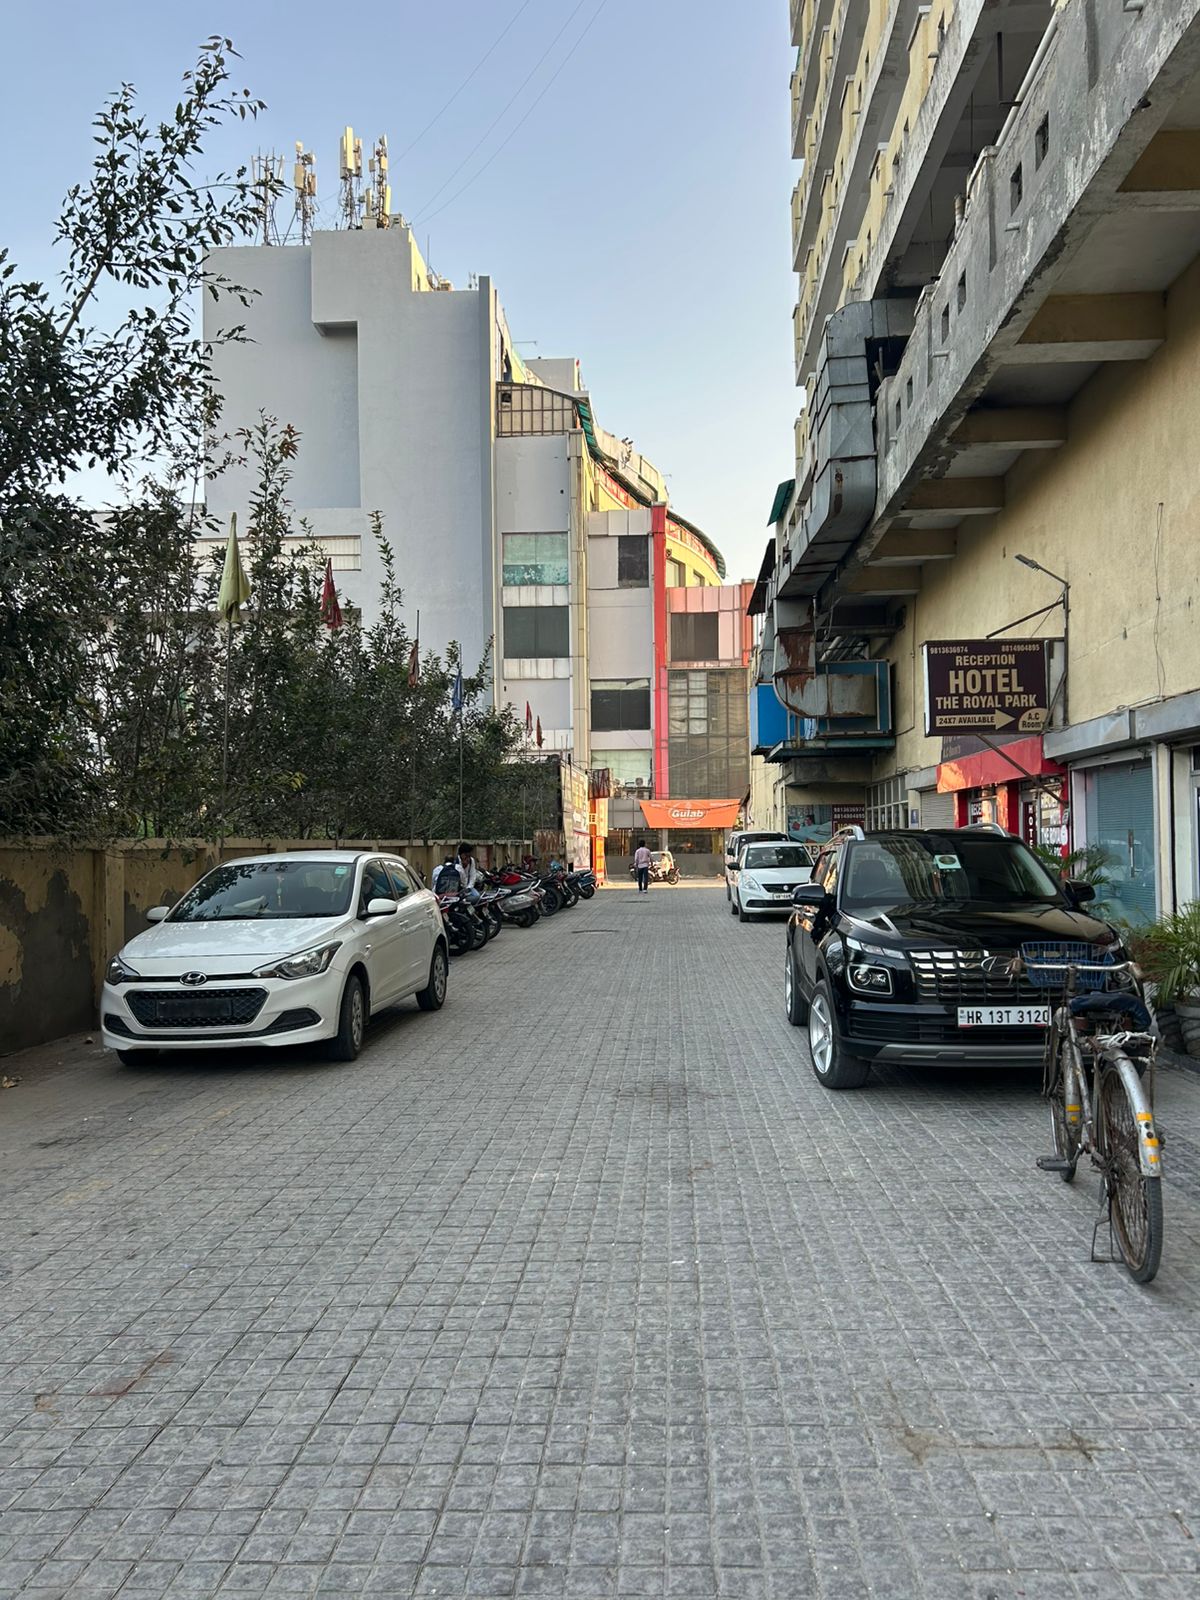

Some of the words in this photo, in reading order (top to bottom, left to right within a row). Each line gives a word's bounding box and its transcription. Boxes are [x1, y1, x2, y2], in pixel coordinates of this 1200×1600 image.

[955, 654, 1016, 666] RECEPTION
[949, 668, 1024, 694] HOTEL
[936, 696, 959, 709] THE
[963, 695, 1001, 709] ROYAL
[1005, 694, 1037, 707] PARK
[939, 717, 956, 725] 24X7
[958, 716, 995, 724] AVAILABLE
[1028, 712, 1040, 721] A.C
[671, 809, 704, 818] Gulab
[967, 1010, 983, 1024] HR
[989, 1010, 1011, 1023] 13T
[1018, 1010, 1049, 1023] 3120
